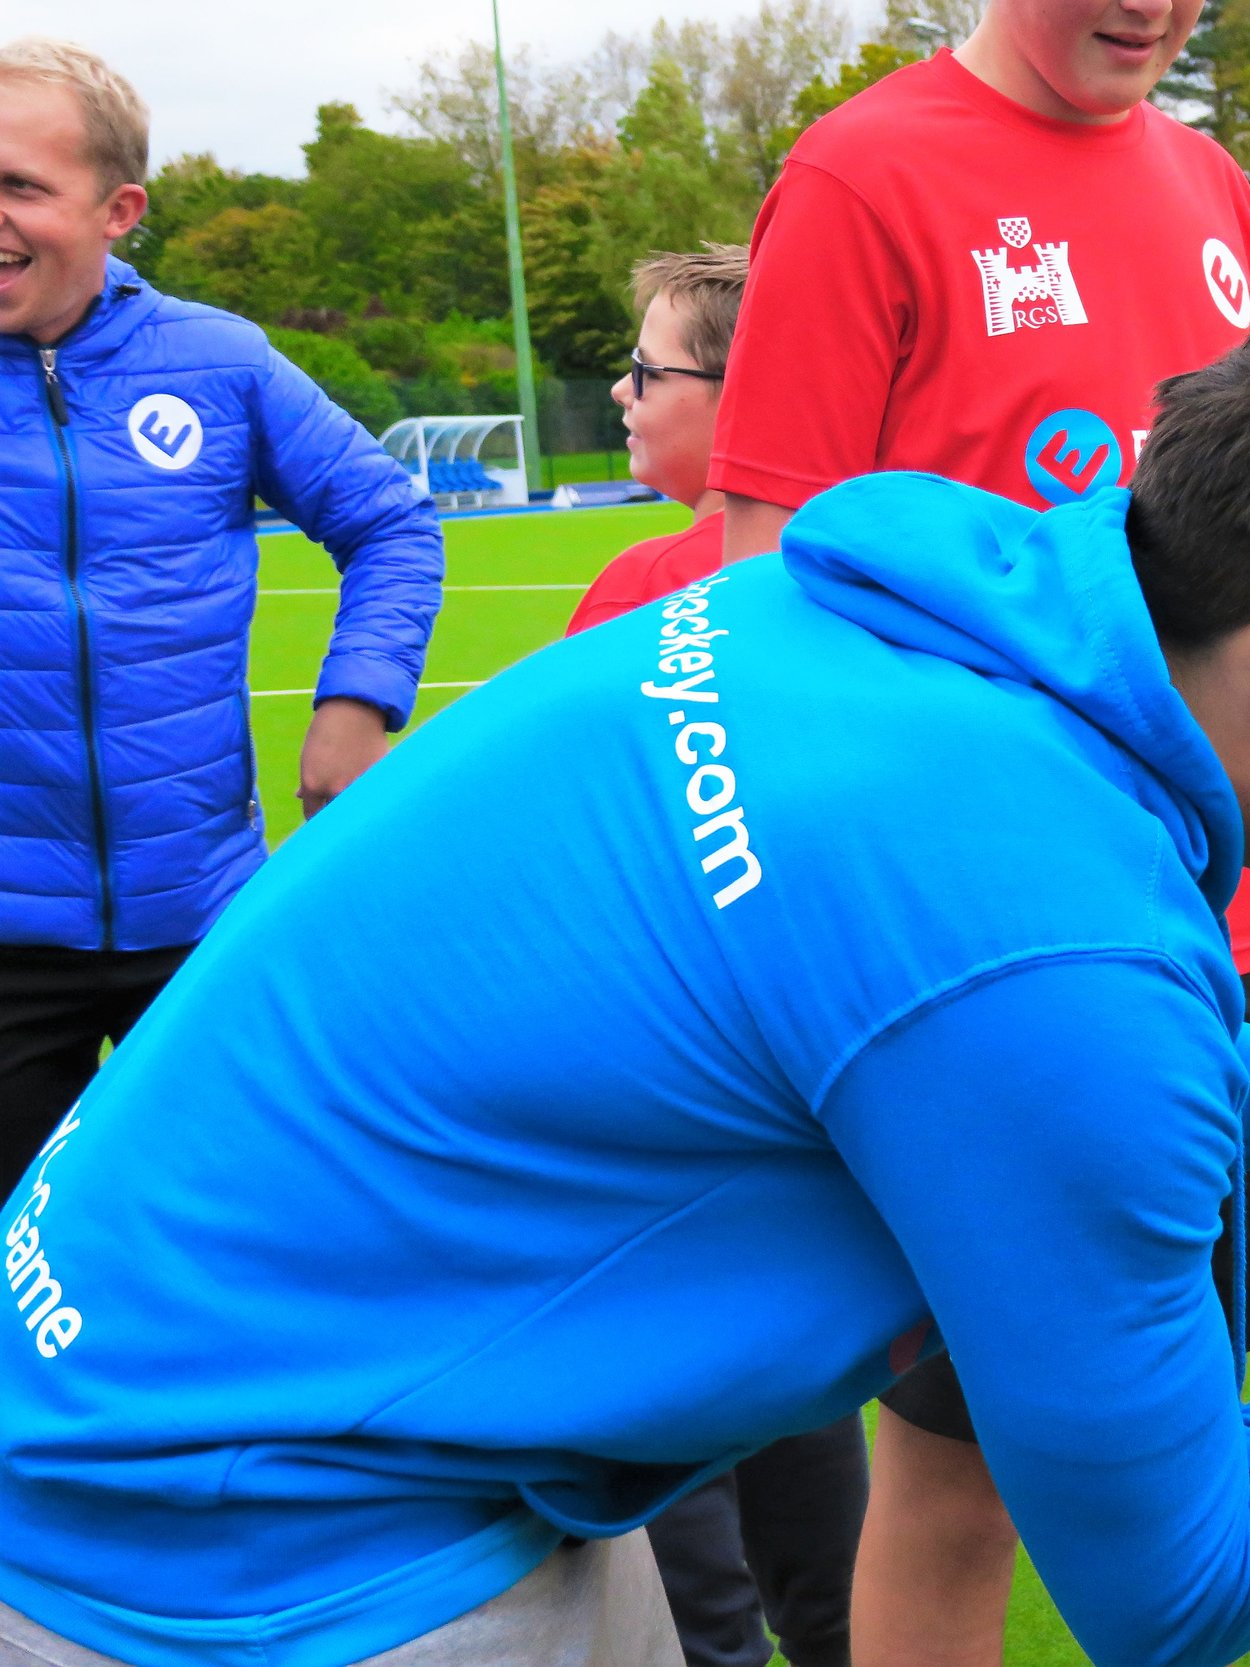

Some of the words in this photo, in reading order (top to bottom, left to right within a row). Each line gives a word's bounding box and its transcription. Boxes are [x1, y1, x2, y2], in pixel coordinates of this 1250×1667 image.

[1014, 306, 1059, 330] RGS
[640, 572, 763, 910] hockey.com
[5, 1183, 83, 1359] Game
